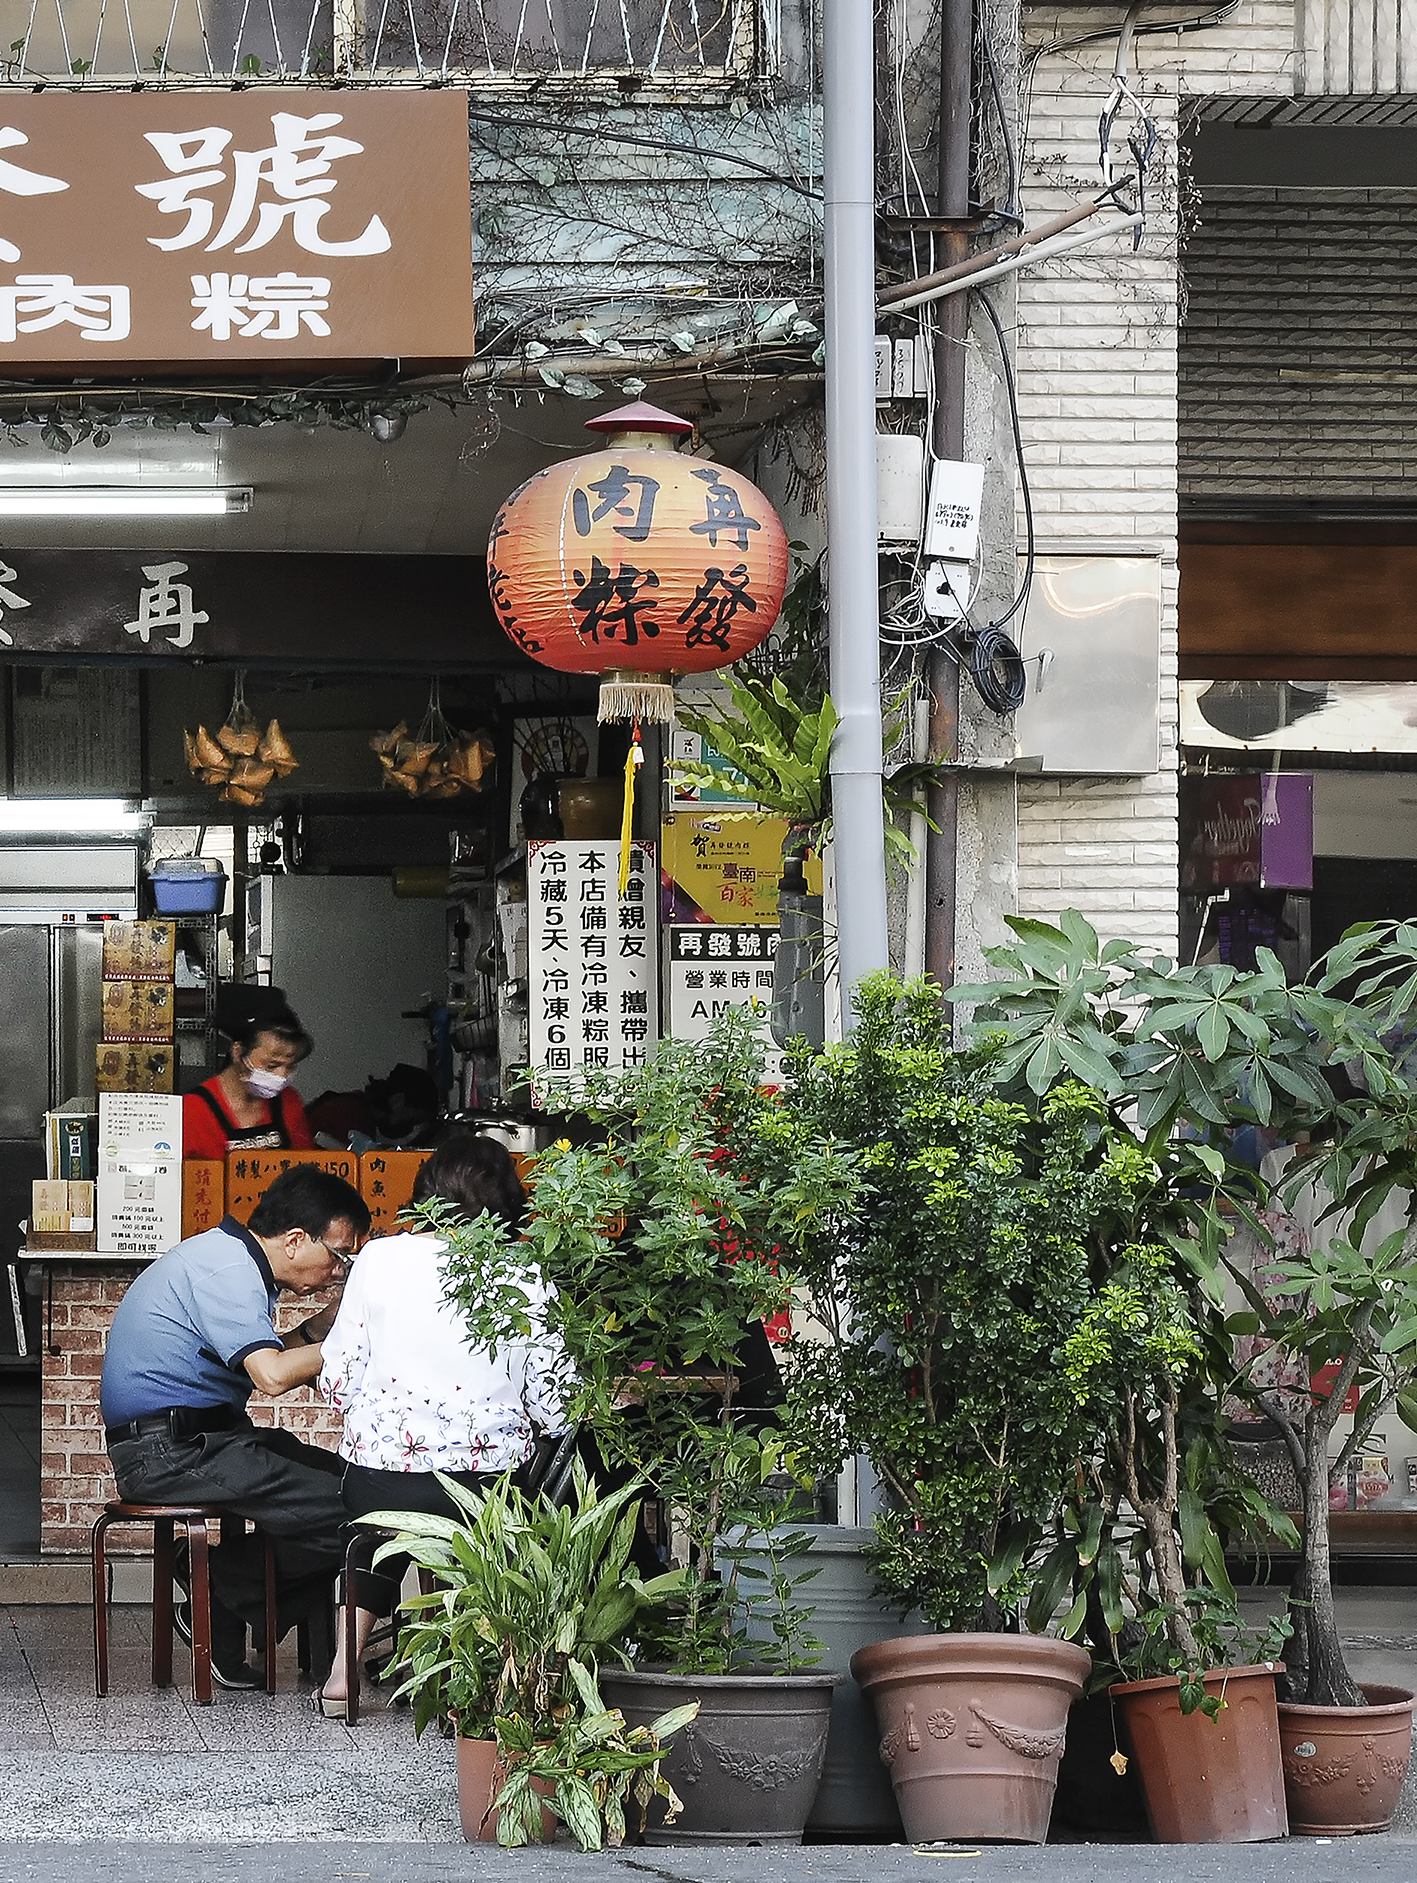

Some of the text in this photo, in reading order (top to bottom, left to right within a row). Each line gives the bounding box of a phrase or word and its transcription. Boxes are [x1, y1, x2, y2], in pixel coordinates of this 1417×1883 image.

[571, 464, 661, 646] 肉粽
[676, 467, 762, 652] 再發
[691, 833, 710, 858] 賀
[539, 850, 571, 1084] 冷藏5天、冷凍6個
[578, 849, 609, 1069] 本店備有冷凍粽服
[617, 849, 648, 1070] 饋贈親友、攜帶出
[684, 969, 775, 990] 營業時間
[193, 1168, 212, 1231] 請先付
